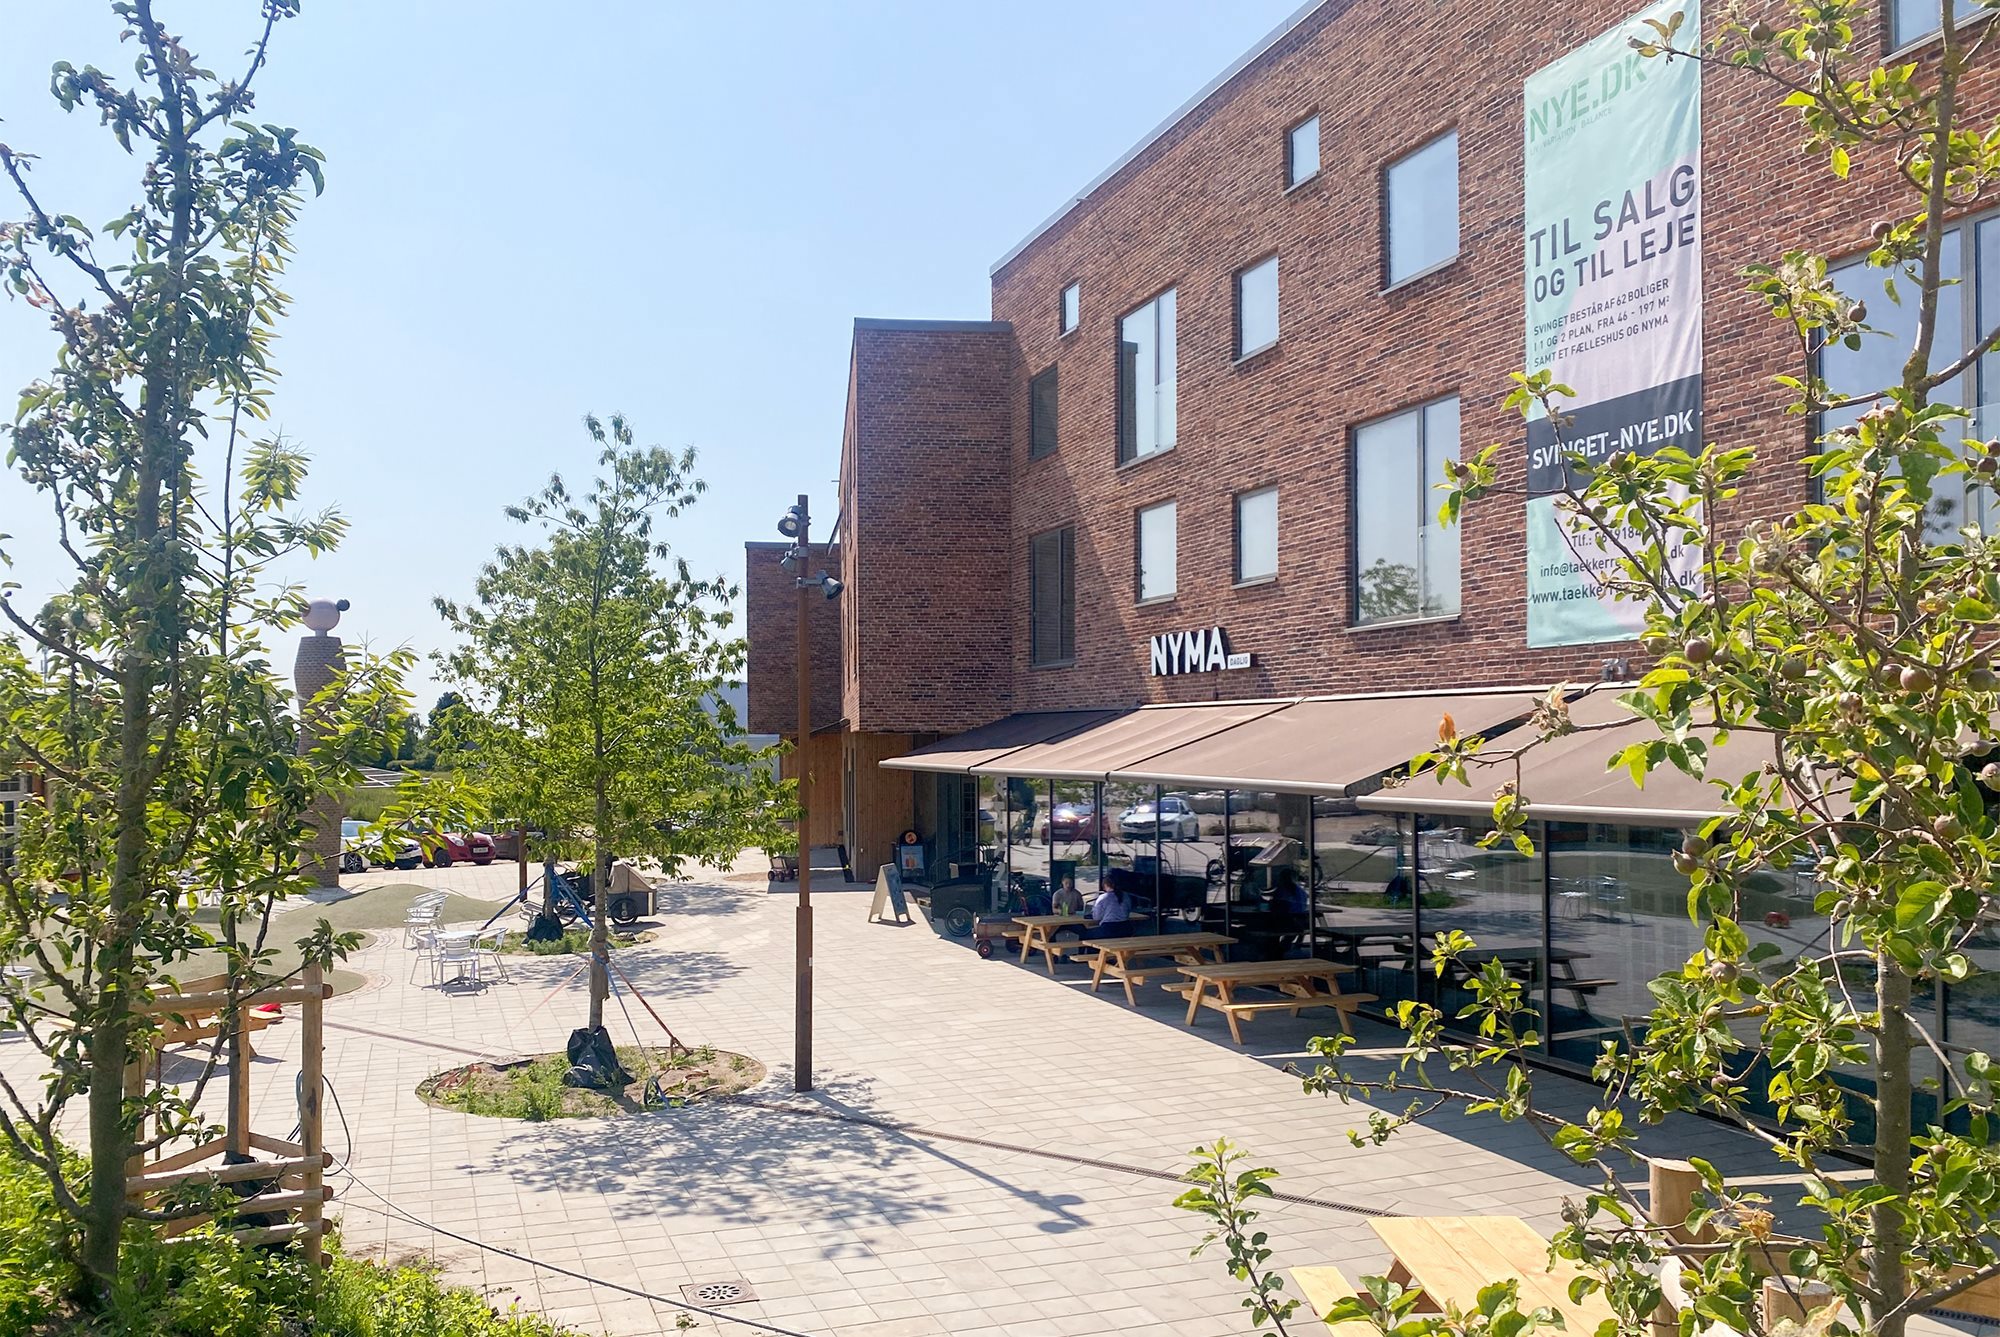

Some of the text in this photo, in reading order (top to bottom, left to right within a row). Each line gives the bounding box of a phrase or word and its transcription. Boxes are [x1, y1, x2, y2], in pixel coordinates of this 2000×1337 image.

[1530, 53, 1647, 143] NYE.DK
[1529, 164, 1695, 268] TIL SALG
[1534, 212, 1695, 303] OG TIL LEJE
[1533, 278, 1669, 336] SVINGET BESTÅR AF 62 BOLIGER
[1547, 335, 1558, 347] OG
[1561, 333, 1566, 342] 2
[1568, 323, 1595, 340] PLAN,
[1597, 314, 1615, 330] FRA
[1617, 311, 1628, 322] 46
[1639, 301, 1655, 315] 197
[1534, 314, 1669, 368] SAMT ET FÆLLESHUS OG NYMA
[1532, 409, 1694, 470] SVINGET-NYE.DK
[1572, 534, 1592, 548] Tlf.:
[1151, 626, 1226, 677] NYMA
